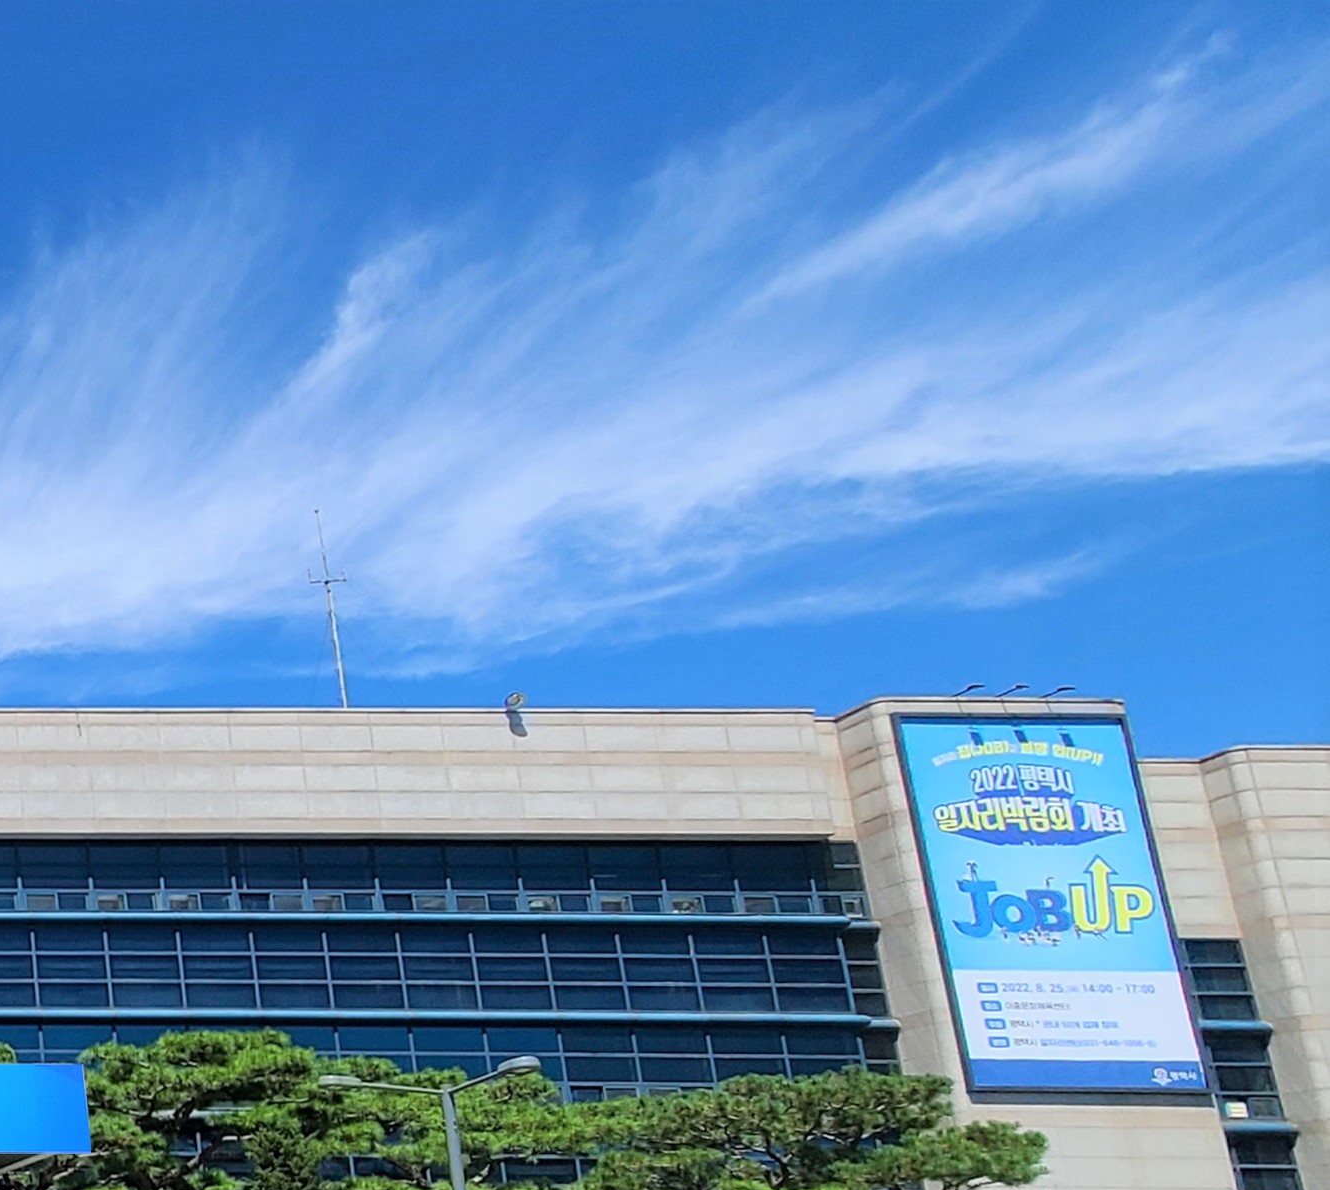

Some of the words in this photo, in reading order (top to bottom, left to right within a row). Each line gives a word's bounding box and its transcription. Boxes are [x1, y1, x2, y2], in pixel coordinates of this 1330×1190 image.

[970, 765, 1017, 793] 2022
[1017, 764, 1075, 794] 평택시
[934, 797, 1075, 832] 일자리박람회
[1076, 801, 1127, 832] 개최
[1001, 983, 1032, 992] 2022.
[1082, 984, 1113, 993] 14:00
